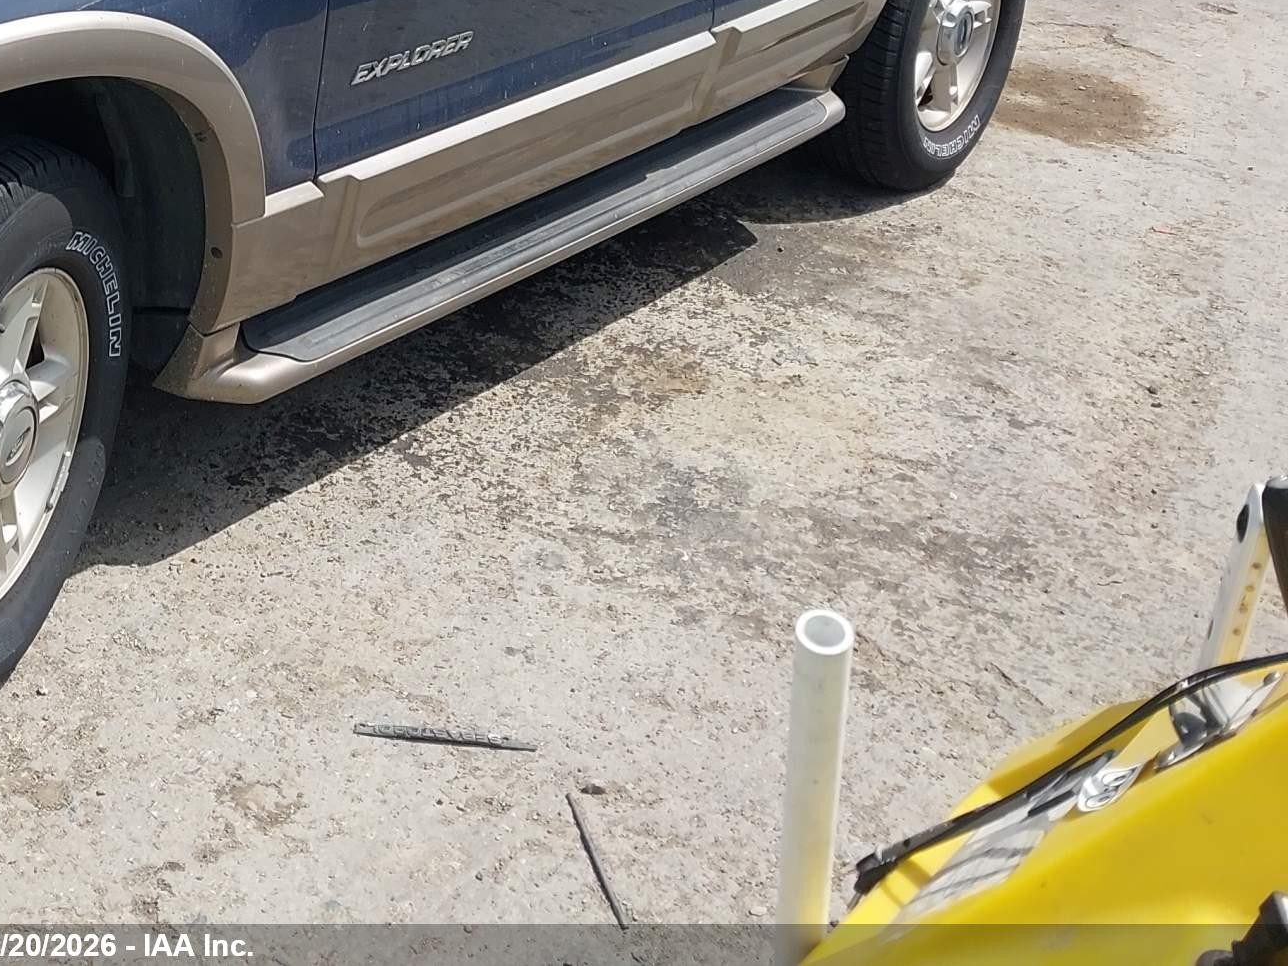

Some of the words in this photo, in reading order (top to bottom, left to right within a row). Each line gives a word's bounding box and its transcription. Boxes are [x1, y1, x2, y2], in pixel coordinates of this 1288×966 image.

[351, 30, 474, 86] EXPLORER
[923, 114, 981, 157] MICHELIN
[65, 231, 122, 357] MICHELIN
